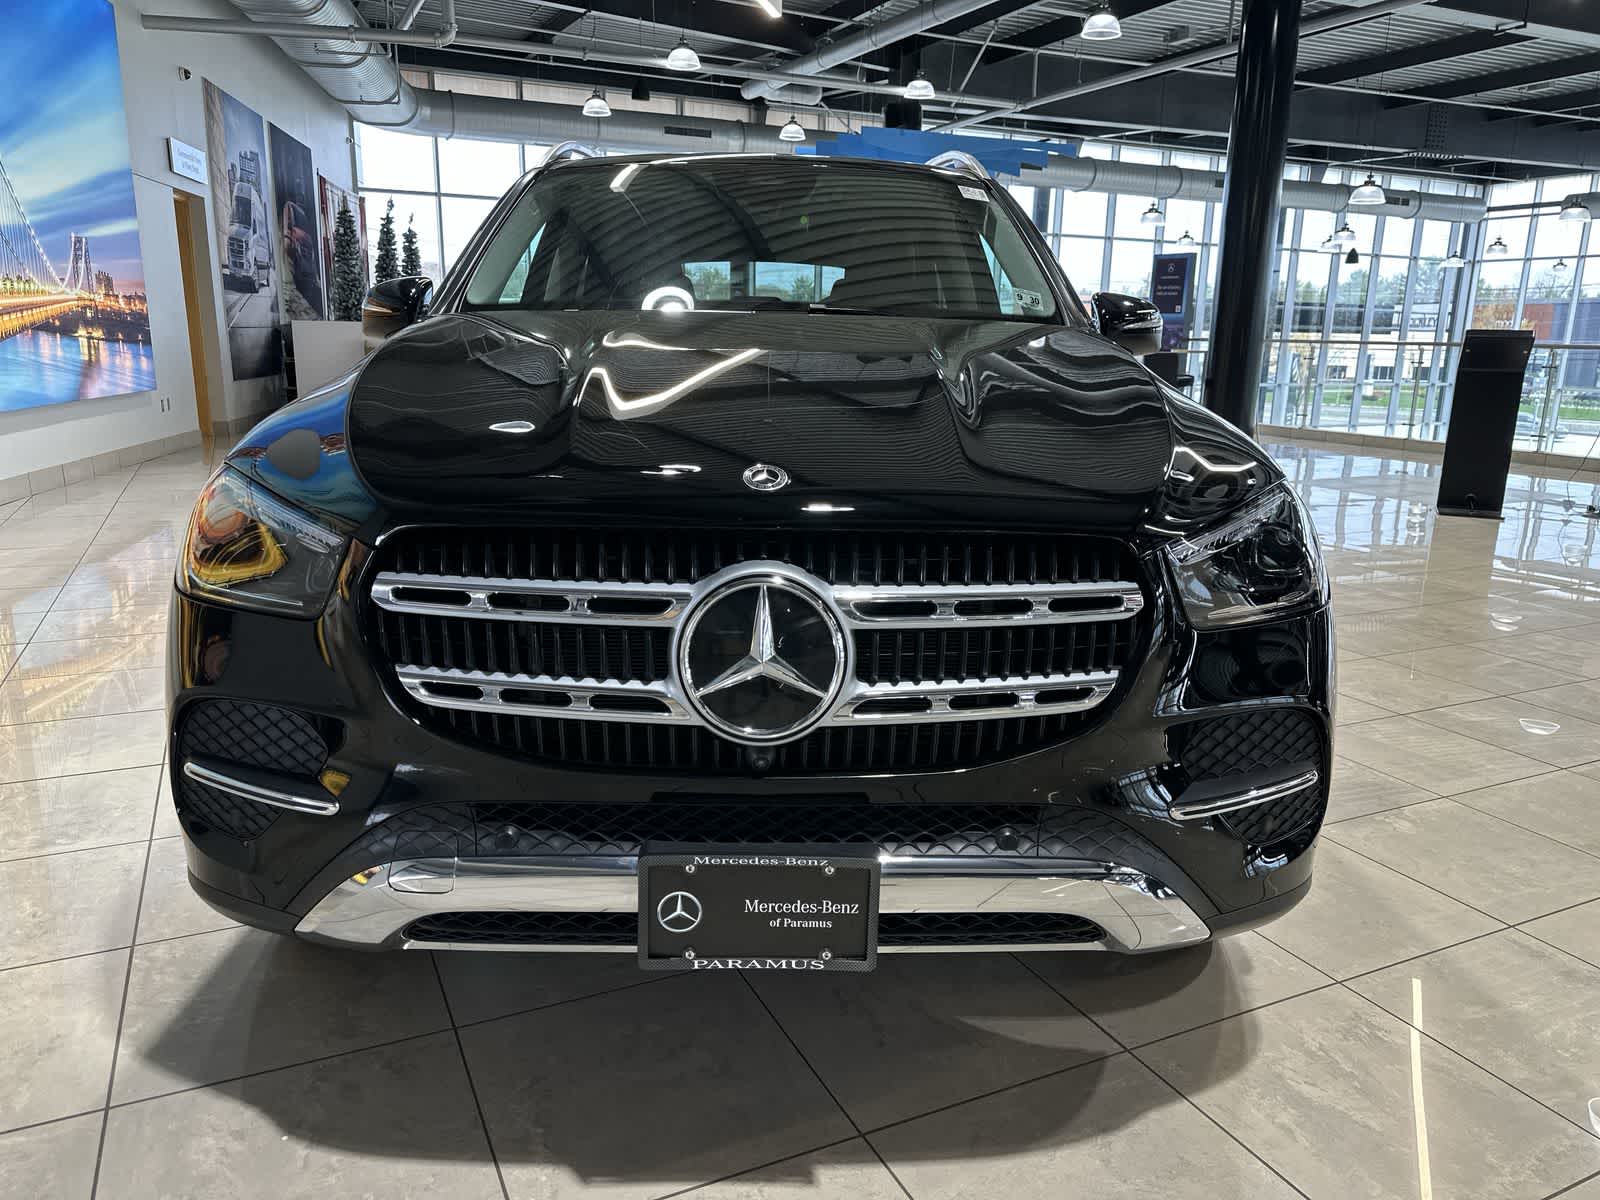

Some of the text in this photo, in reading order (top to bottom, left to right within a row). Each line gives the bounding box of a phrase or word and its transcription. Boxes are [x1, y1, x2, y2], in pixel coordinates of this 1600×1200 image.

[1029, 296, 1040, 305] 30
[693, 856, 829, 866] Mercedes-Benz
[744, 899, 859, 914] Mercedes-Benz
[769, 918, 832, 928] of Paramus
[692, 959, 825, 970] PARAMUS
